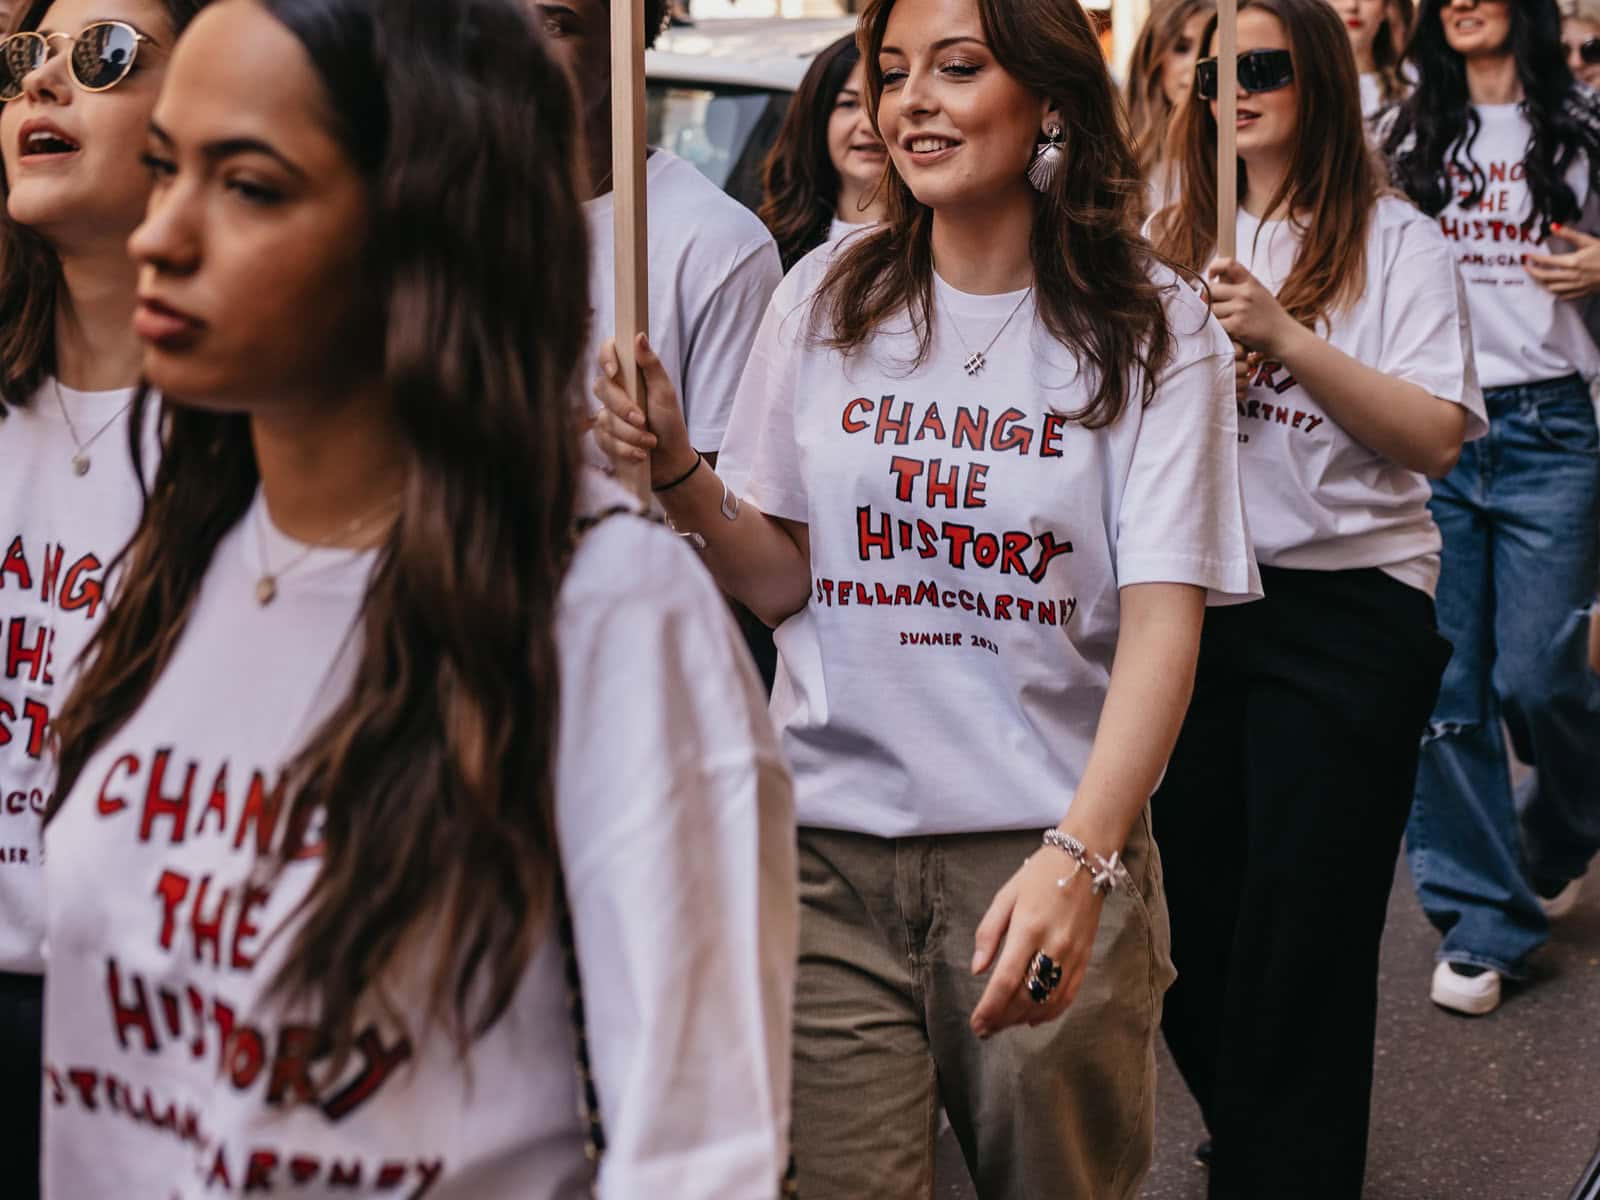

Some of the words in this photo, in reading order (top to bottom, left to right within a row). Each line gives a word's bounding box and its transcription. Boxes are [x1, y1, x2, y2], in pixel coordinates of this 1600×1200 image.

[842, 395, 1067, 457] CHANGE
[890, 455, 989, 508] THE
[857, 505, 1073, 583] HISTORY
[900, 631, 962, 647] SUMMER
[156, 869, 268, 969] THE
